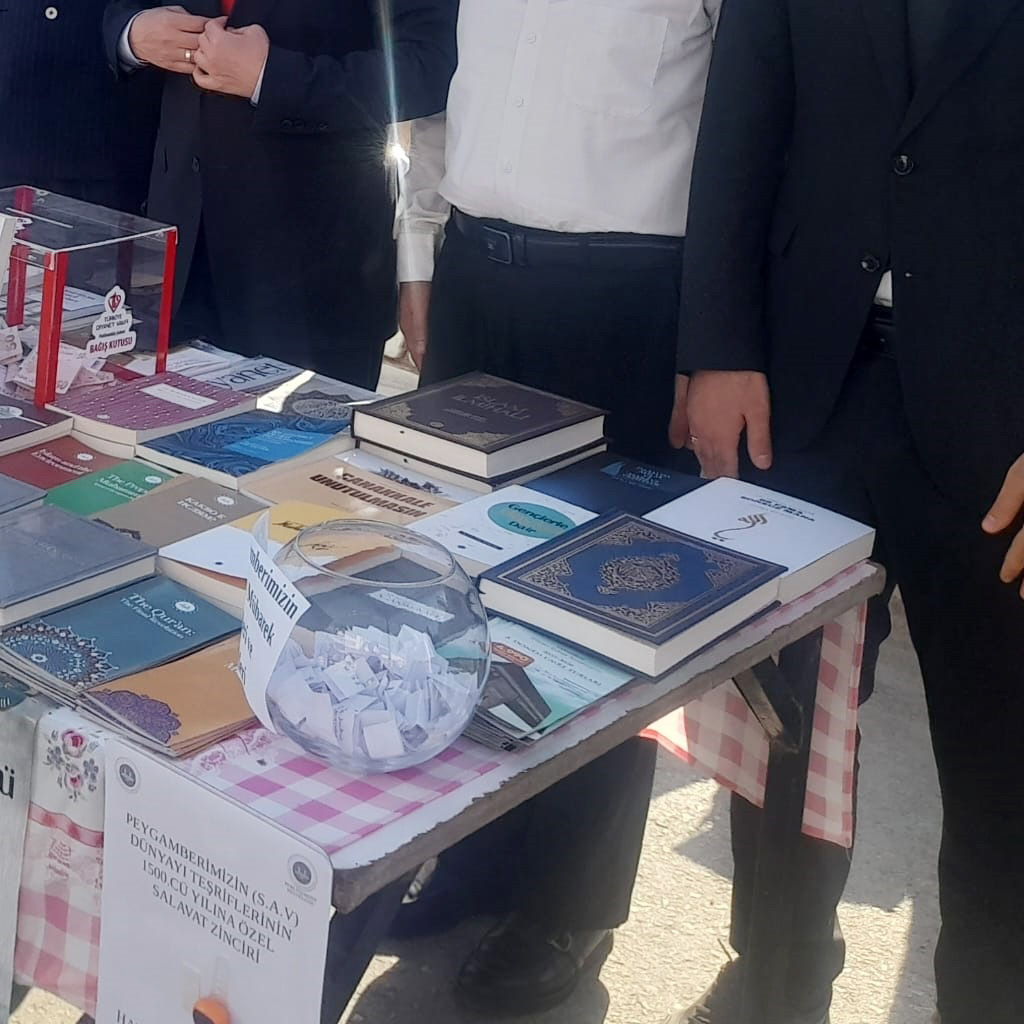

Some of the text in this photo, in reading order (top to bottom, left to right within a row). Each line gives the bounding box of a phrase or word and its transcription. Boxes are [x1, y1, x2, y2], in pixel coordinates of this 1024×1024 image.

[89, 336, 133, 353] BAĞIŞ KUTUSU
[309, 474, 428, 518] UNUTULMASIN
[126, 812, 249, 897] PEYGAMBERİMİZİN
[251, 889, 300, 928] (S.A.V)
[130, 832, 187, 878] DÜNYAYI
[190, 868, 293, 941] TEŞRİFLERİNİN
[152, 884, 260, 964] SALAVAT ZİNCİRİ
[191, 890, 235, 929] YILINA
[238, 919, 275, 953] ÖZEL
